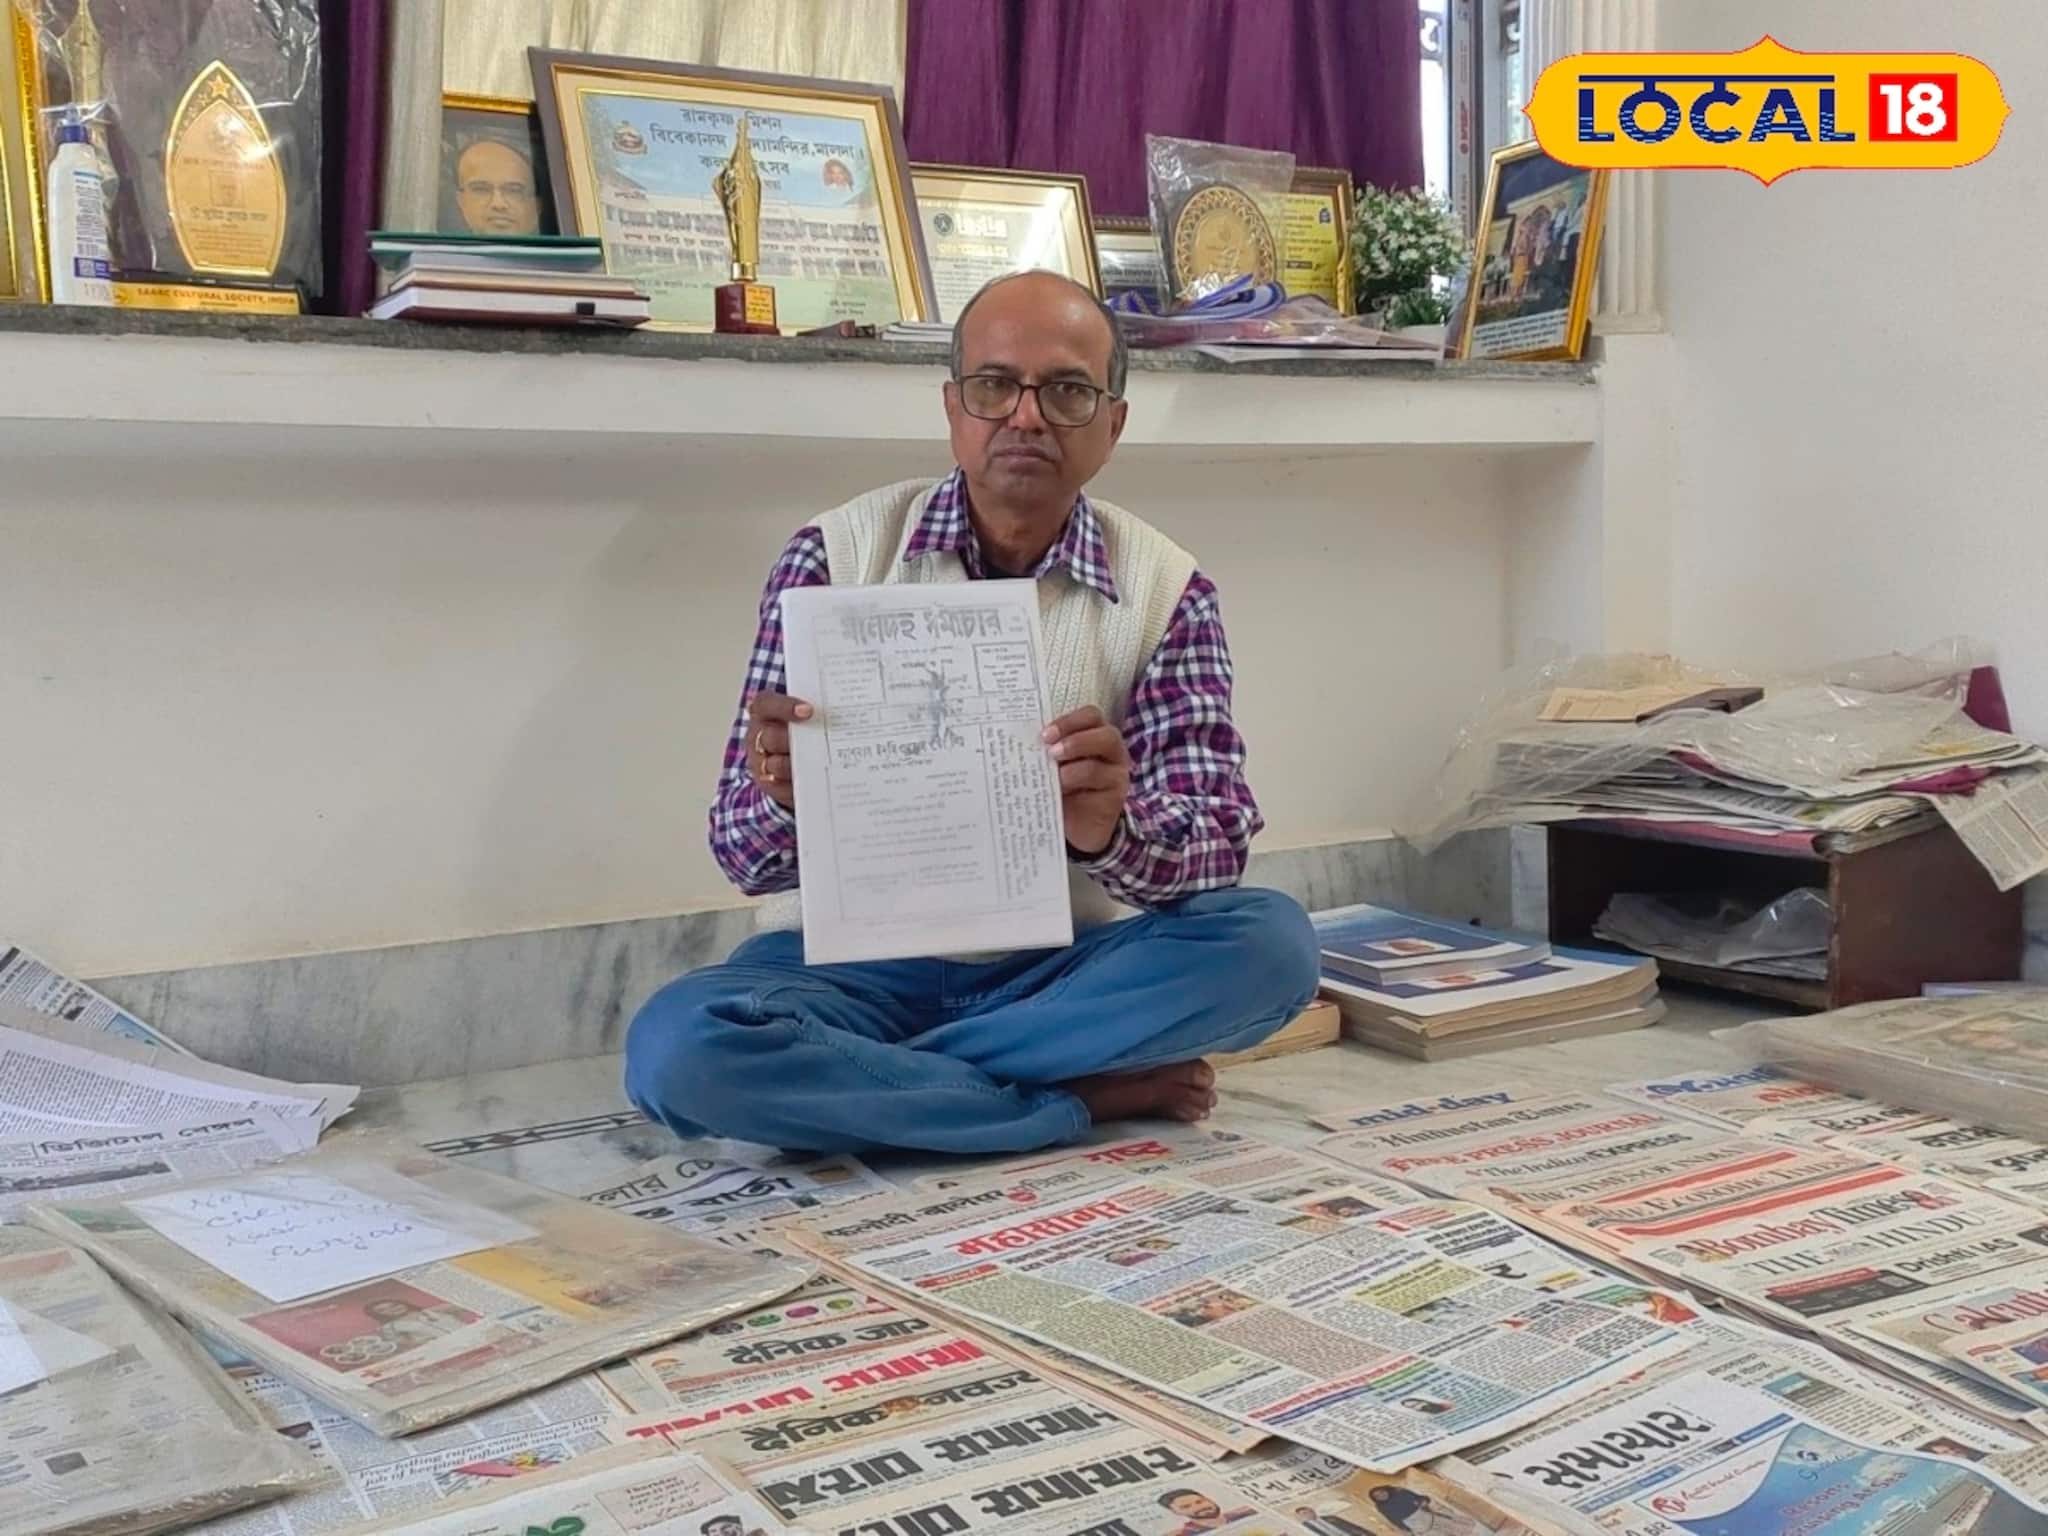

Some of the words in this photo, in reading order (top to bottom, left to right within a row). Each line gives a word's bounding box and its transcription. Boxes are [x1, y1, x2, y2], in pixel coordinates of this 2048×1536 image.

[1349, 1091, 1518, 1127] mid-day
[1746, 1248, 1834, 1277] THE
[1866, 1210, 1990, 1249] HINDU
[722, 1333, 849, 1367] दैनिक
[740, 1399, 889, 1453] दैनिक
[1523, 1410, 1712, 1490] સમાચાર
